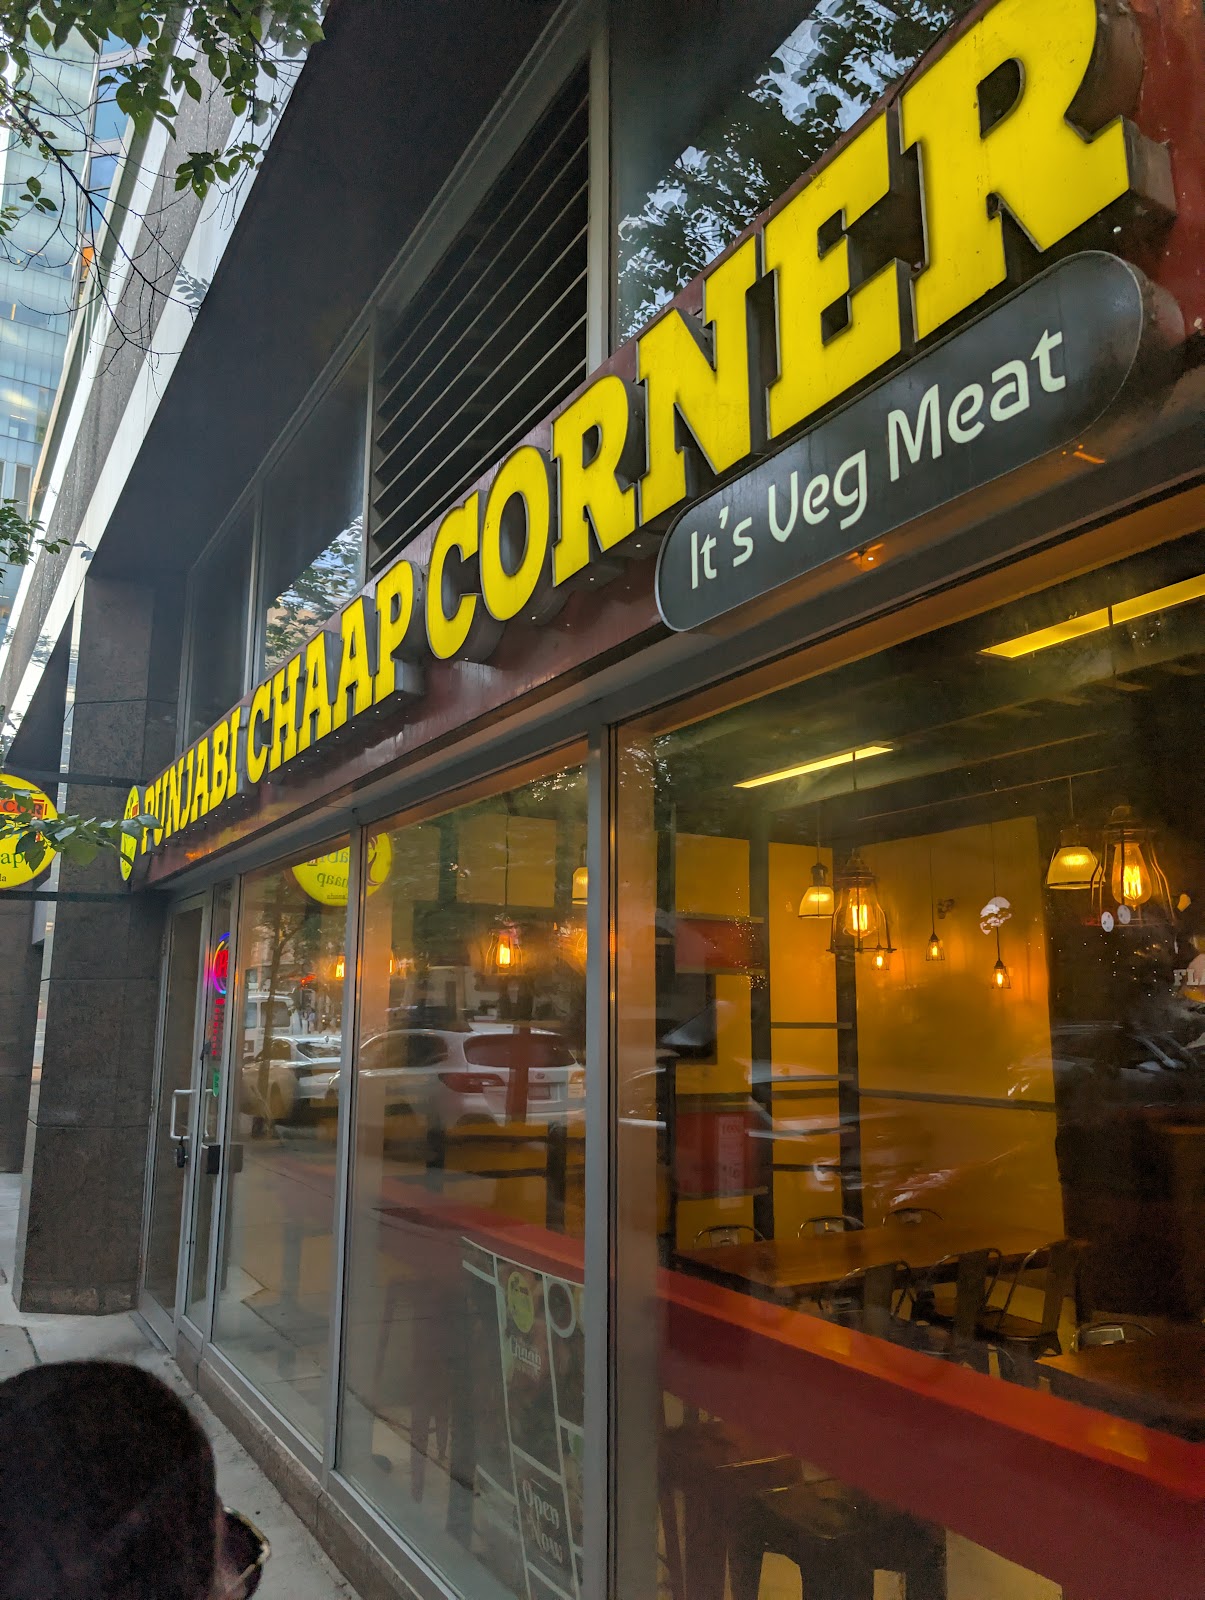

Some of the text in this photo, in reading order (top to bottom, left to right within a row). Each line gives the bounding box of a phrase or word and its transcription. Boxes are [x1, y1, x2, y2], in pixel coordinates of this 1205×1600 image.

[141, 706, 242, 856] PUNJABI
[246, 559, 414, 784] CHAAP
[426, 0, 1130, 660] CORNER
[690, 329, 1067, 590] It's Veg Meat
[522, 1479, 560, 1530] Open
